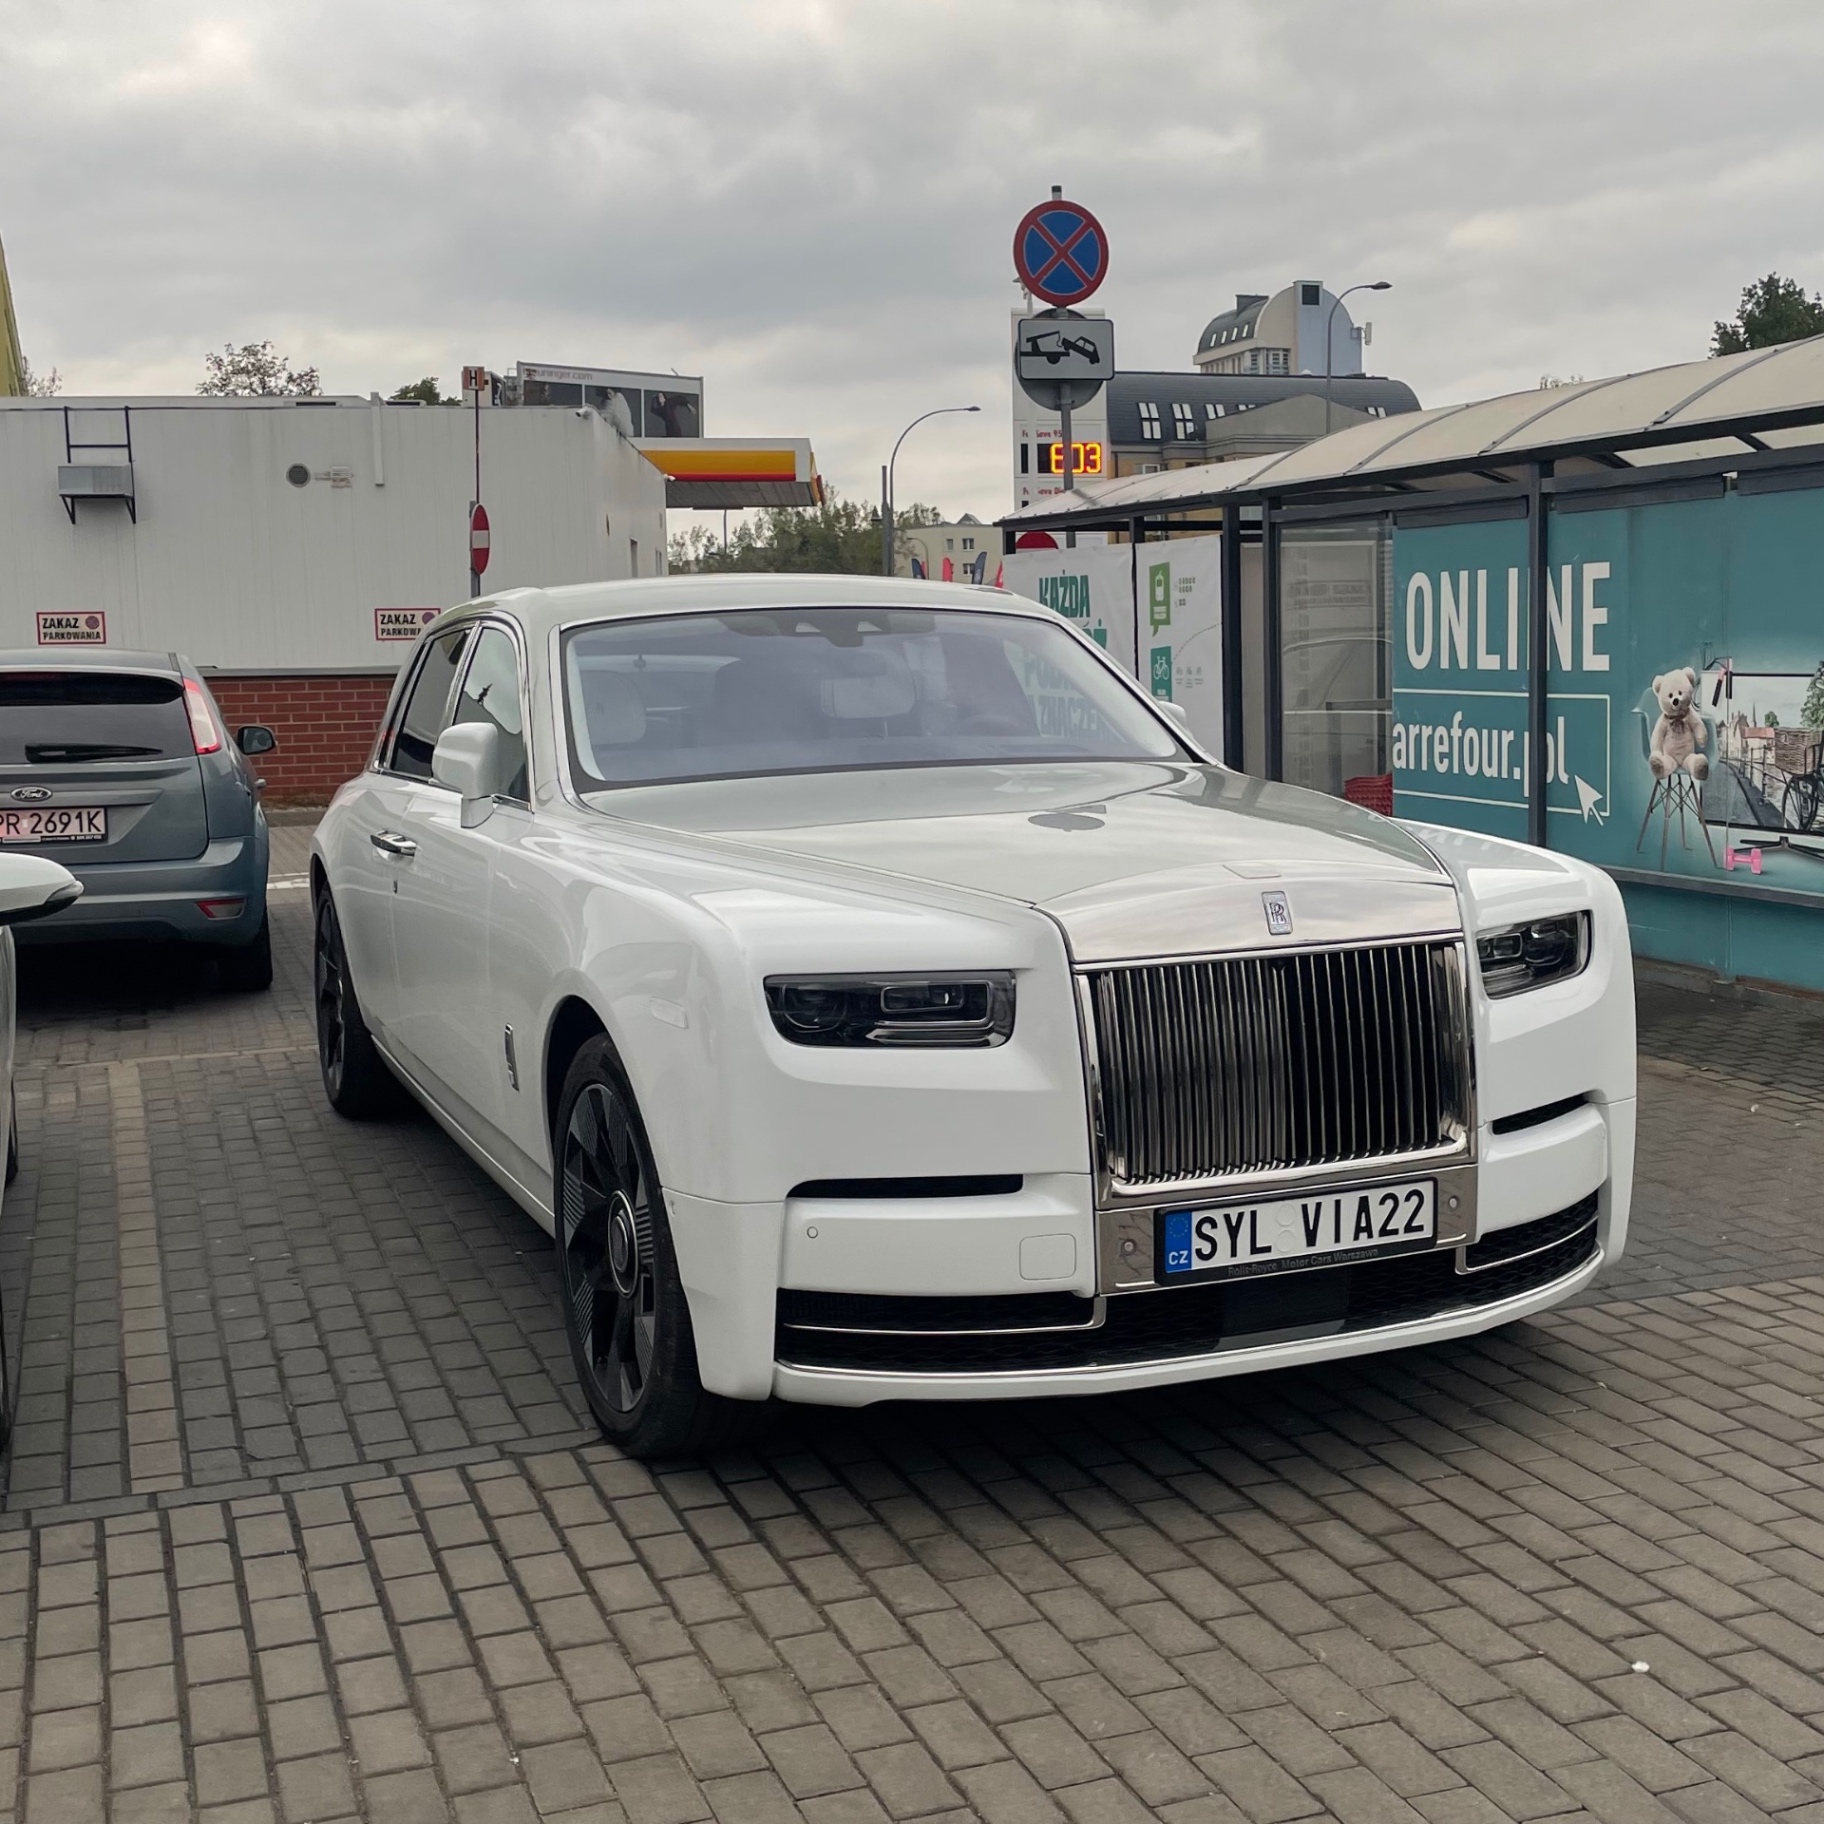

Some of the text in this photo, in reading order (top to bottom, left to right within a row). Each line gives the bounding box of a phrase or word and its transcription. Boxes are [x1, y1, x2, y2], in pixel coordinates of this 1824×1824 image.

[1039, 569, 1091, 618] KAŻDA
[42, 617, 79, 629] ZAKAZ
[380, 613, 416, 625] ZAKAZ
[1406, 562, 1610, 671] ONLINE
[43, 631, 101, 640] PARKOWANIA
[381, 627, 422, 636] PARKOWA
[20, 788, 43, 798] Ford
[29, 810, 101, 834] 2691K
[1195, 1209, 1272, 1261] SYL
[1168, 1250, 1189, 1266] CZ
[1228, 1248, 1379, 1276] Rolls-Royce Motor Cars Warszawa
